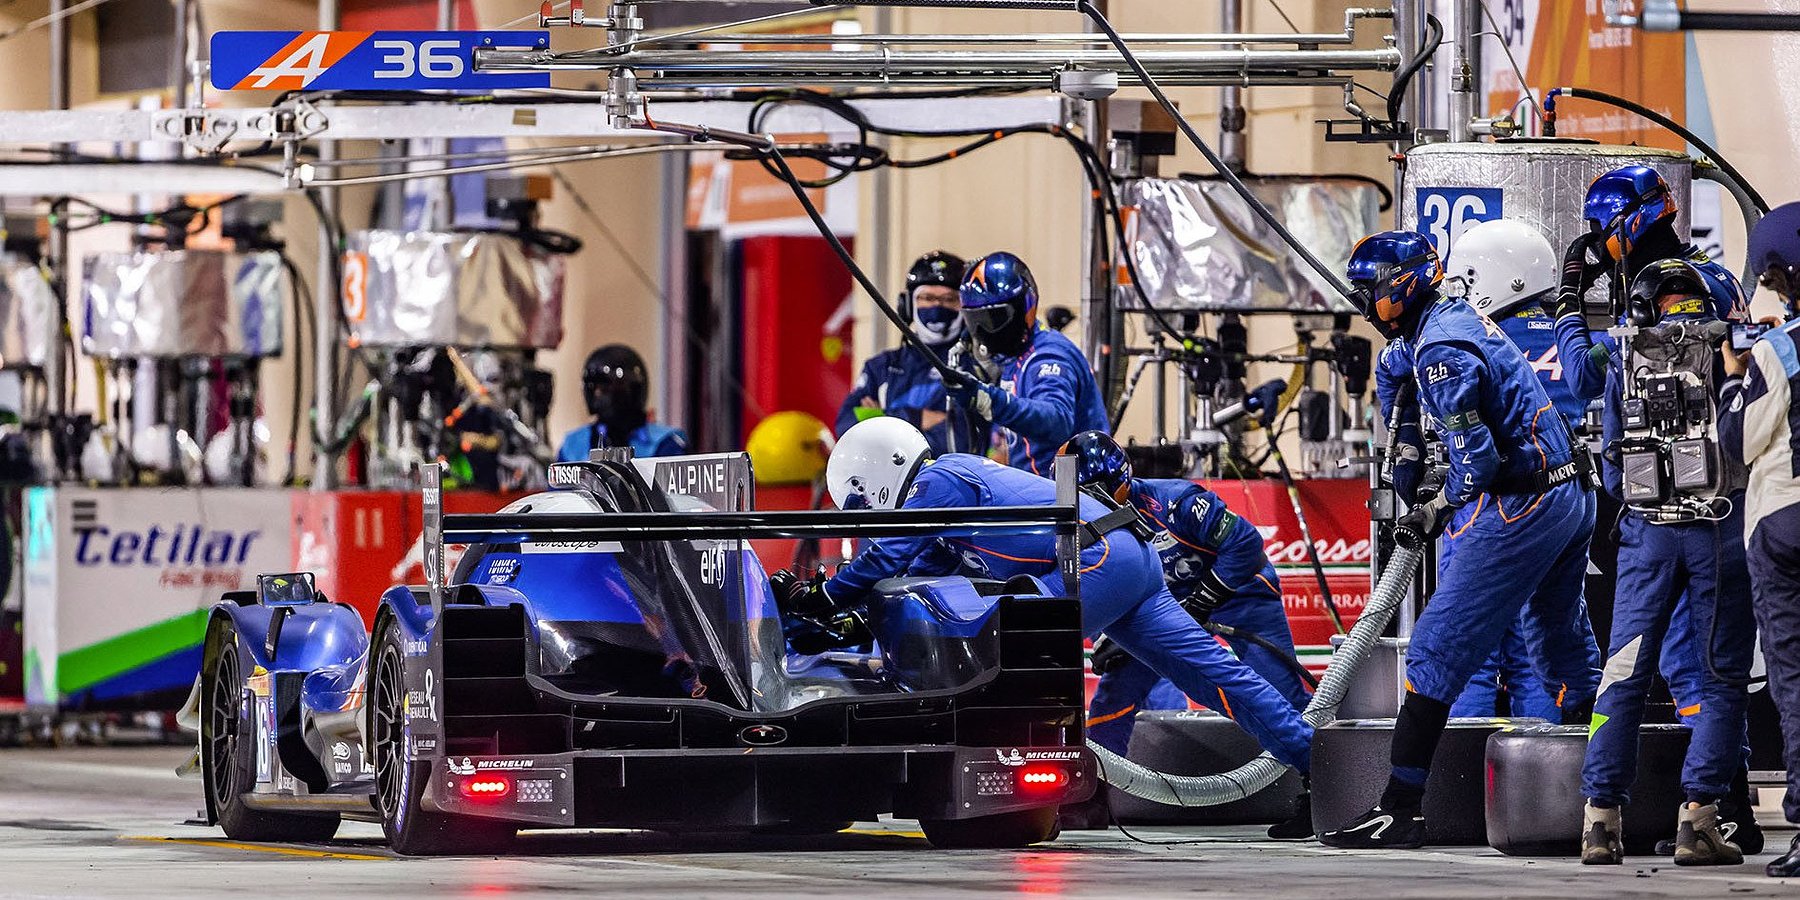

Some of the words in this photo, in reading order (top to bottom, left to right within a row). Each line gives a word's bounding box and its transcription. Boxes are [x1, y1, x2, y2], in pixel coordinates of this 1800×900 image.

[374, 41, 464, 79] 36
[1426, 362, 1448, 380] 24h
[555, 466, 581, 484] TISSOT
[1454, 434, 1474, 502] ALPNE
[1548, 462, 1578, 484] MRTC
[667, 463, 725, 495] ALPINE
[423, 487, 439, 504] TISSOT
[701, 547, 718, 585] elf
[478, 759, 534, 768] MICHELIN
[1026, 751, 1081, 760] MICHELIN
